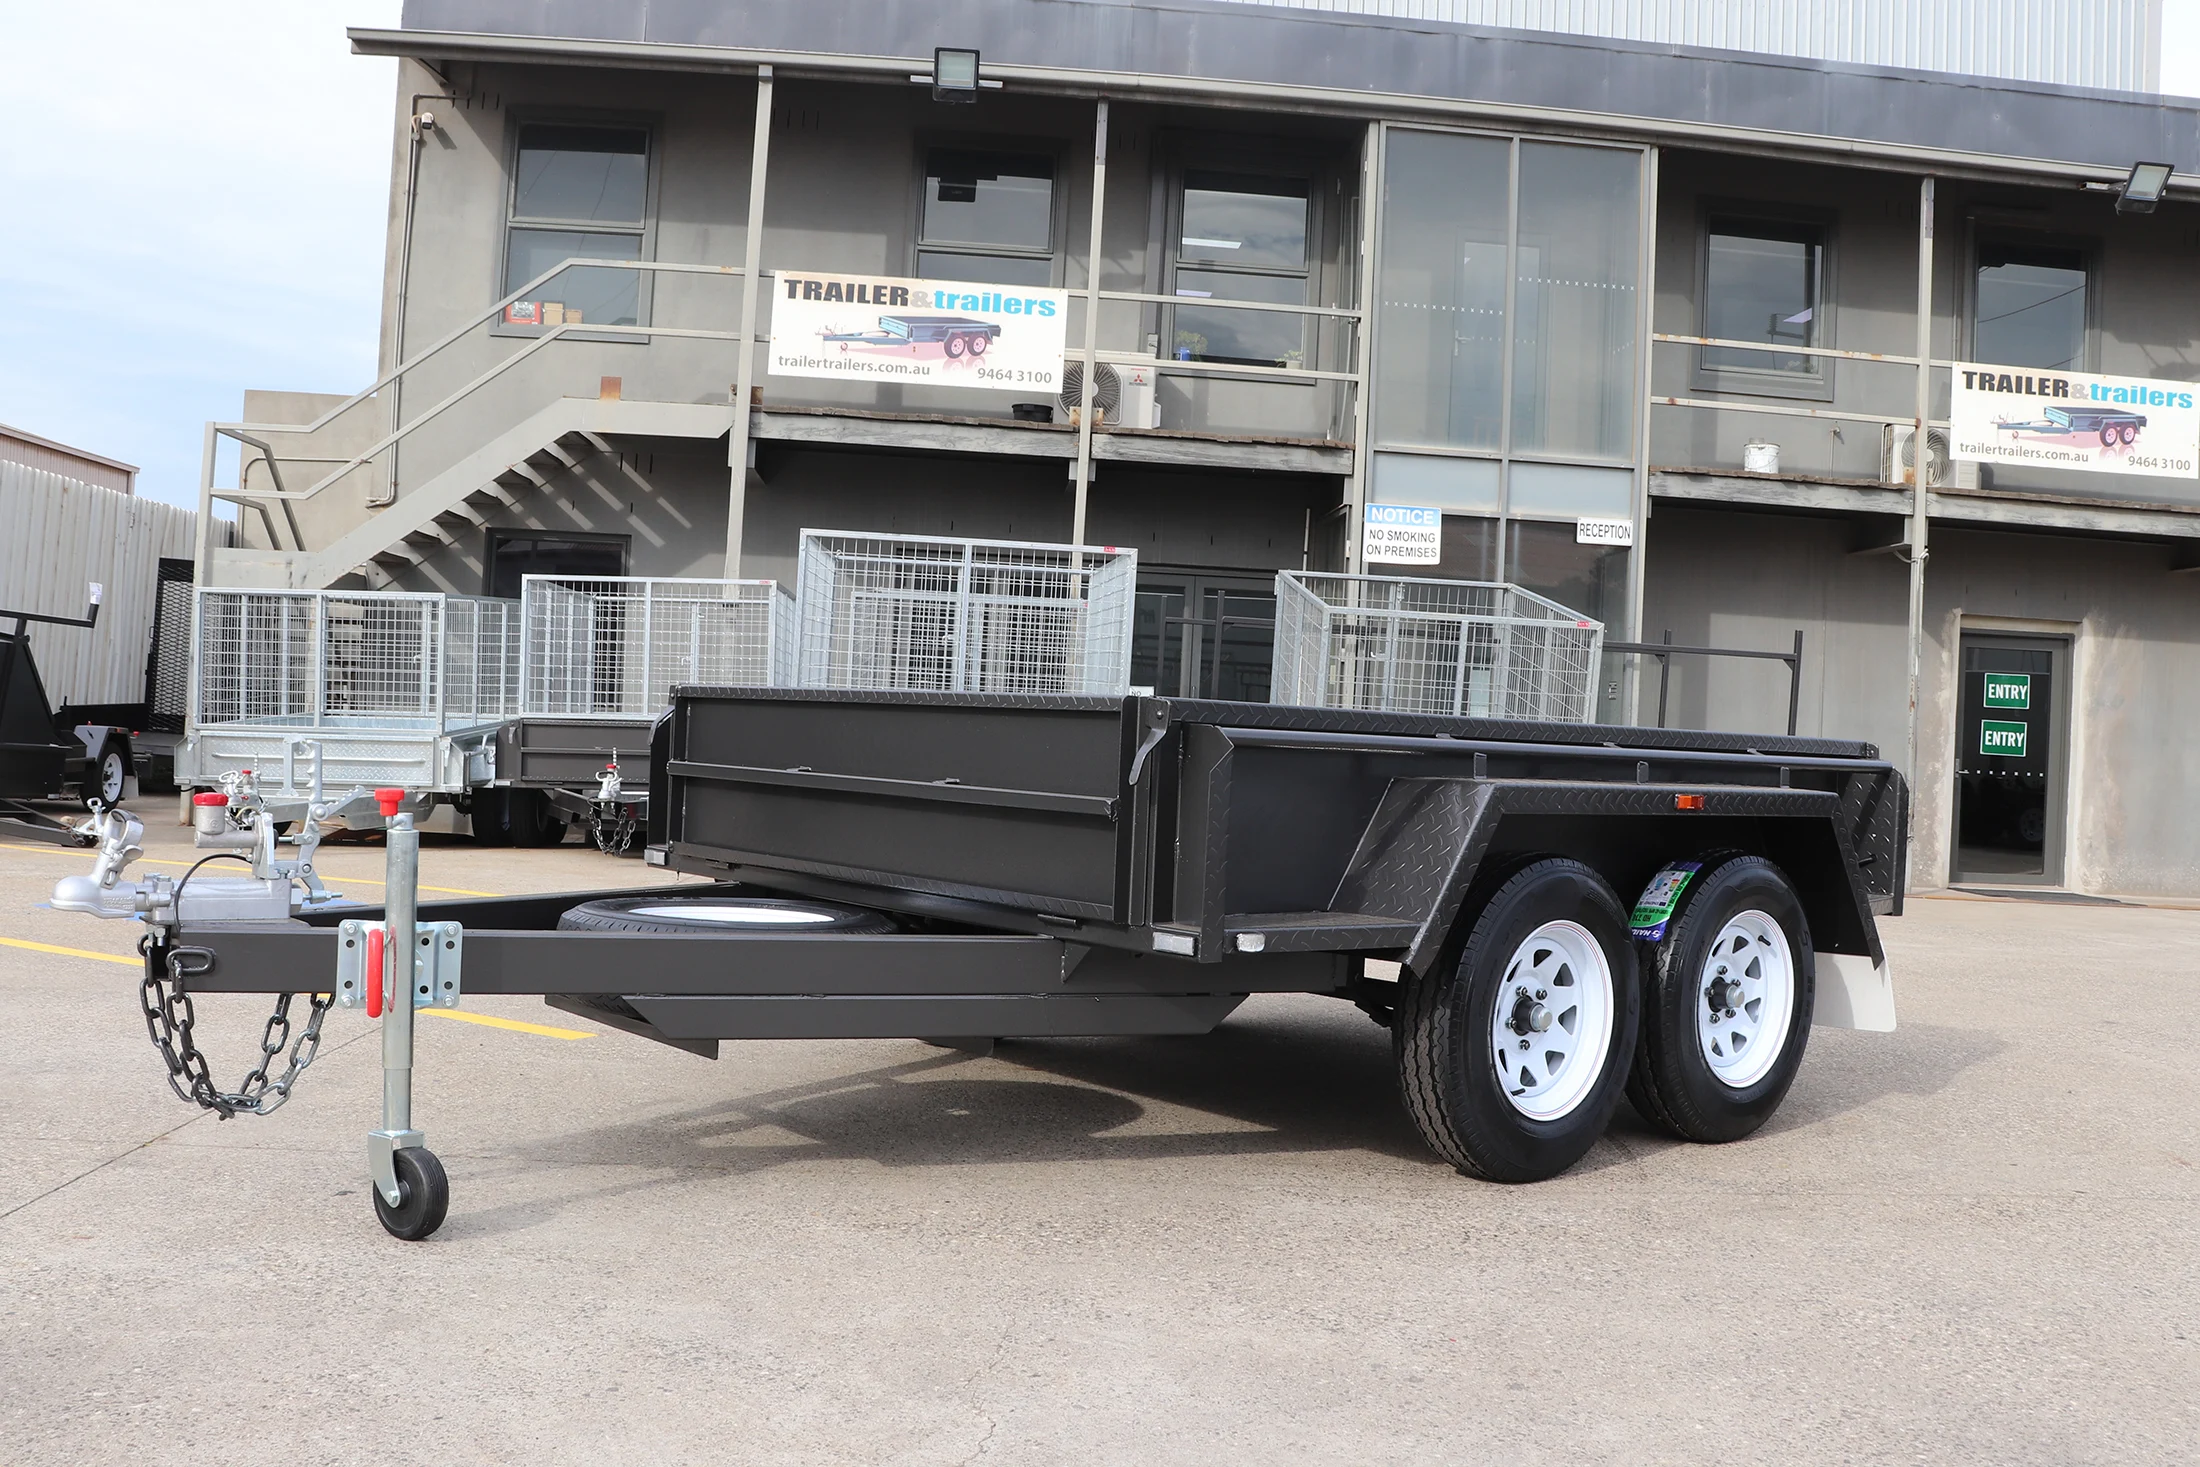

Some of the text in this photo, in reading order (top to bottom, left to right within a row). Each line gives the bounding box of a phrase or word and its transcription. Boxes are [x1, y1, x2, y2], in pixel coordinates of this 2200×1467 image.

[778, 354, 931, 376] trailertrailers.com.au
[977, 366, 1053, 384] 9464 3100
[1959, 442, 2089, 463] trailertrailers.com.au
[2128, 455, 2191, 471] 9464 3100
[1371, 507, 1435, 525] NOTICE
[1369, 529, 1436, 543] NO SMOKING
[1579, 523, 1631, 540] RECEPTION
[1366, 544, 1437, 558] ON PREMISES
[1988, 684, 2027, 699] ENTRY
[1985, 731, 2024, 747] ENTRY
